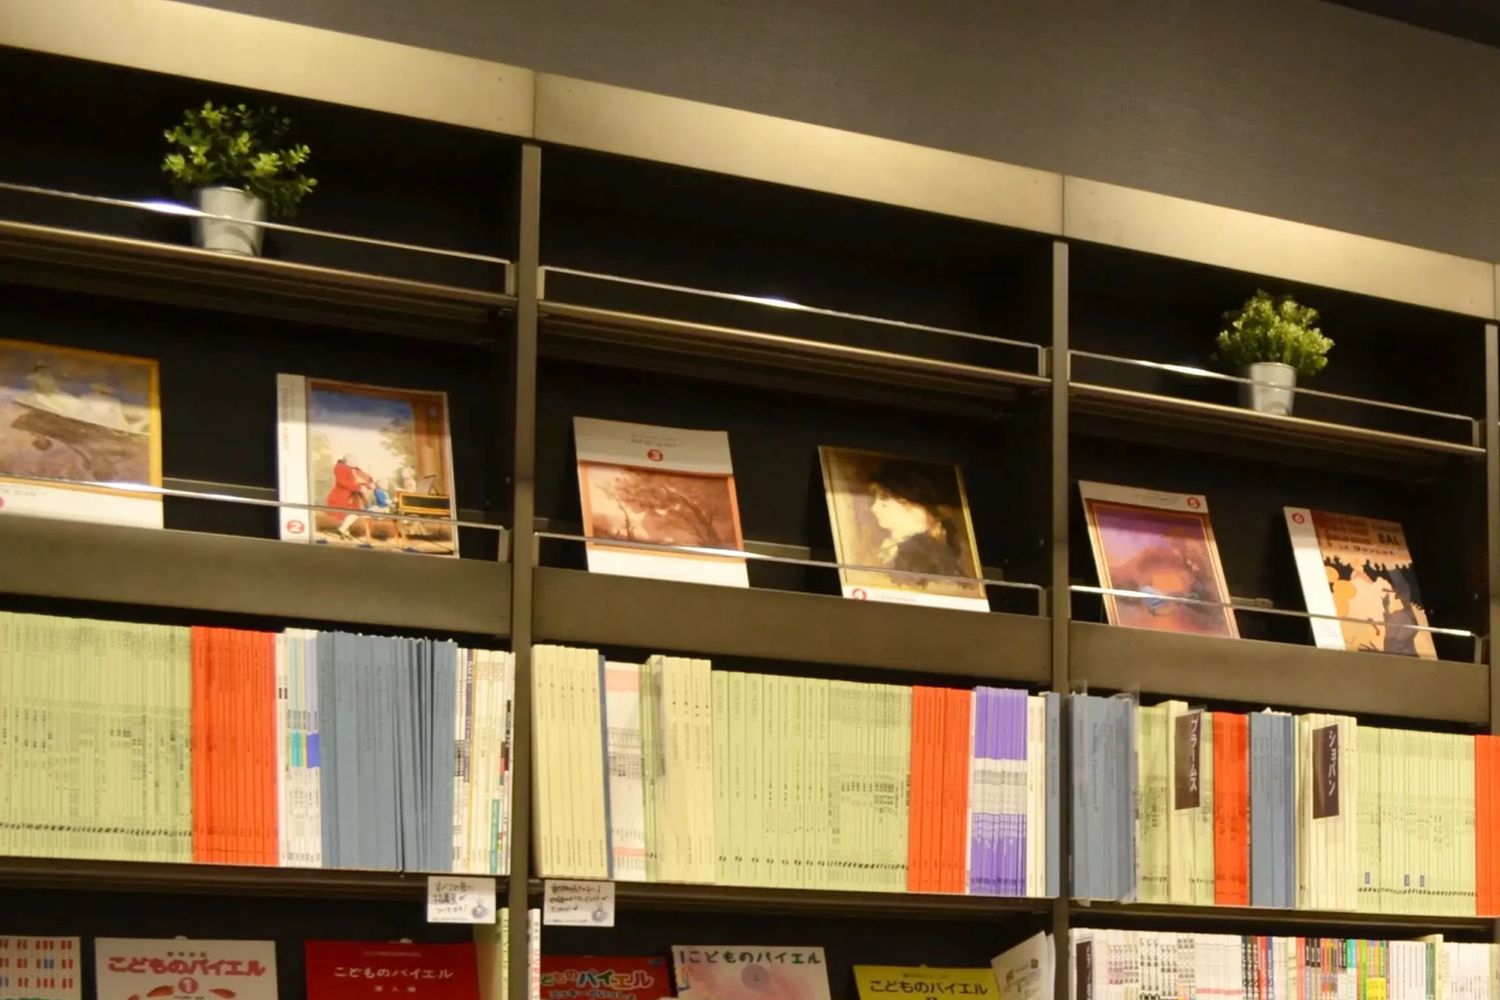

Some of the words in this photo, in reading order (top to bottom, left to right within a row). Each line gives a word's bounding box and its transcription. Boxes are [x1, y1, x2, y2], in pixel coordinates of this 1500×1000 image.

[1377, 532, 1400, 545] BAL
[1189, 718, 1198, 792] ブラームス
[1328, 730, 1337, 796] ショパン
[108, 956, 266, 977] こどものバイエル
[688, 950, 822, 966] こどものバイエル
[333, 965, 454, 980] こどものバイエル
[869, 978, 989, 996] こどものバイエル
